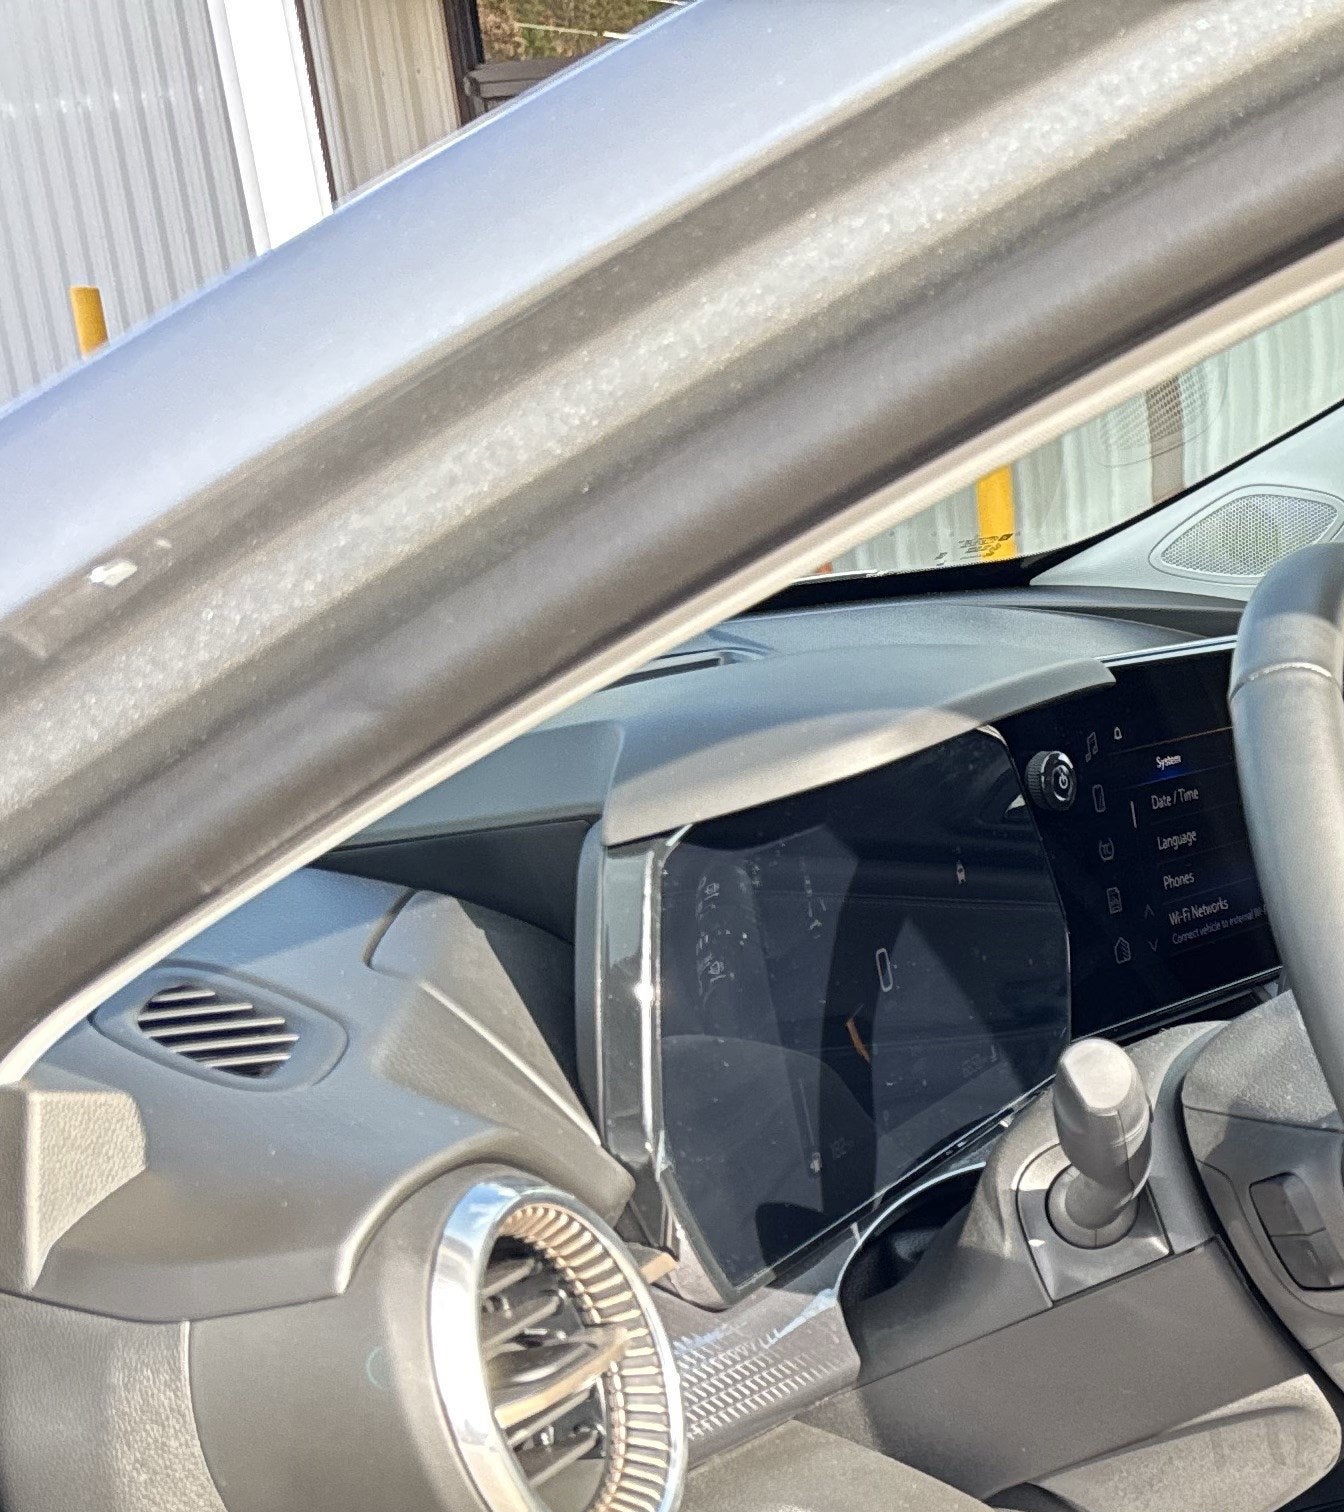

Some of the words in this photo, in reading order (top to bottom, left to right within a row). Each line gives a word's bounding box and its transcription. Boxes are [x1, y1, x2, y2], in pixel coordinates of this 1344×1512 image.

[1155, 755, 1182, 770] System
[1150, 795, 1172, 810] Date
[1177, 788, 1199, 802] Time
[1157, 831, 1197, 850] Language
[1163, 873, 1195, 890] Phones
[1168, 907, 1192, 926] Wi-Fi
[1191, 897, 1229, 918] Networks
